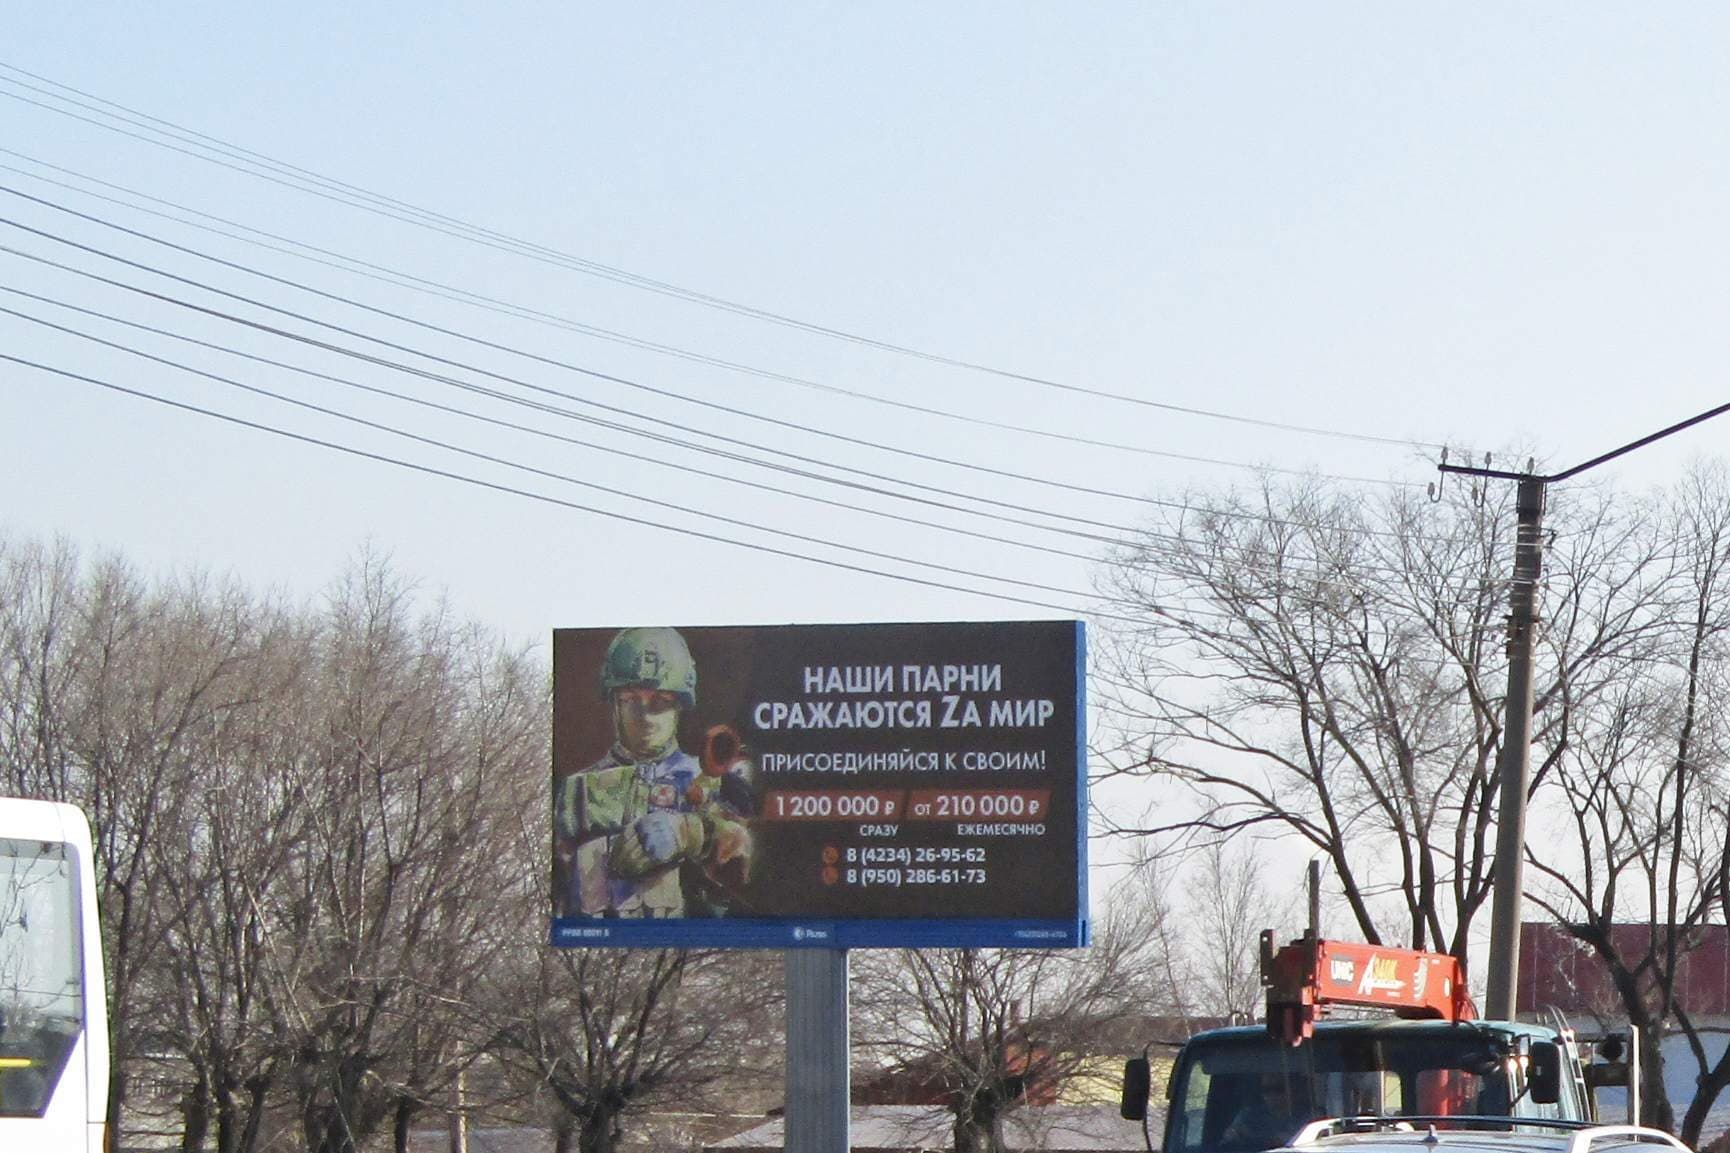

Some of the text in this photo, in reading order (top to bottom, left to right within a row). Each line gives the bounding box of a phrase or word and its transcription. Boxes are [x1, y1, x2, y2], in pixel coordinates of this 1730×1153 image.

[804, 664, 1001, 693] НАШИ ПАРНИ
[754, 701, 932, 729] СРАЖАЮТСЯ
[989, 700, 1055, 727] МИР
[762, 749, 1047, 774] ПРИСОЕДИНЯЙСЯ К СВОИМ!
[859, 824, 899, 836] СРАЗУ
[957, 823, 1046, 836] ЕЖЕМЕСЯЧНО
[846, 847, 986, 866] 8 (4234) 26-95-62
[846, 868, 986, 887] 8 (950) 286-61-73
